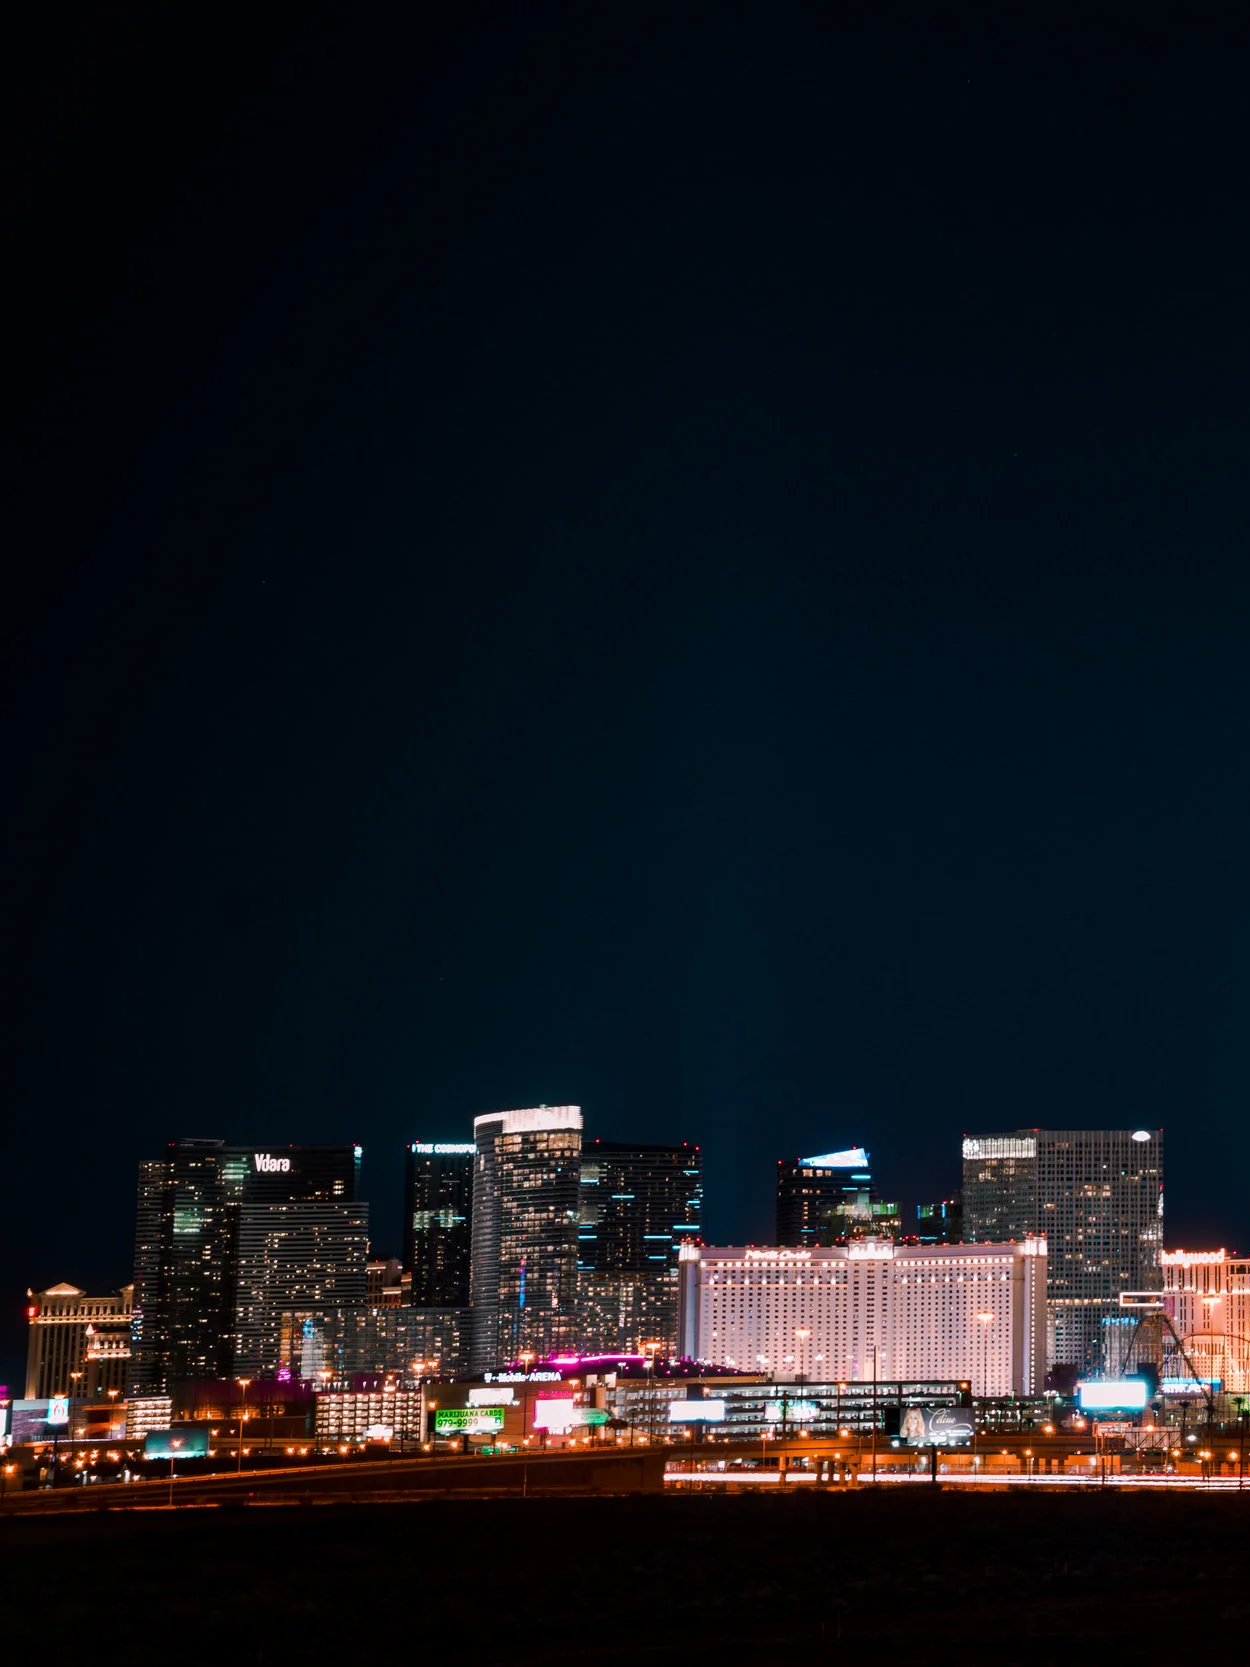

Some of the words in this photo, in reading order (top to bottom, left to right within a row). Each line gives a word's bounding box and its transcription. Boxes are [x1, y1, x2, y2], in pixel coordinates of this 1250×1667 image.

[254, 1153, 291, 1172] Vdara
[1161, 1247, 1225, 1269] hollywood
[528, 1371, 562, 1382] ARENA
[480, 1409, 503, 1417] CARDS
[437, 1418, 479, 1428] 979-9999
